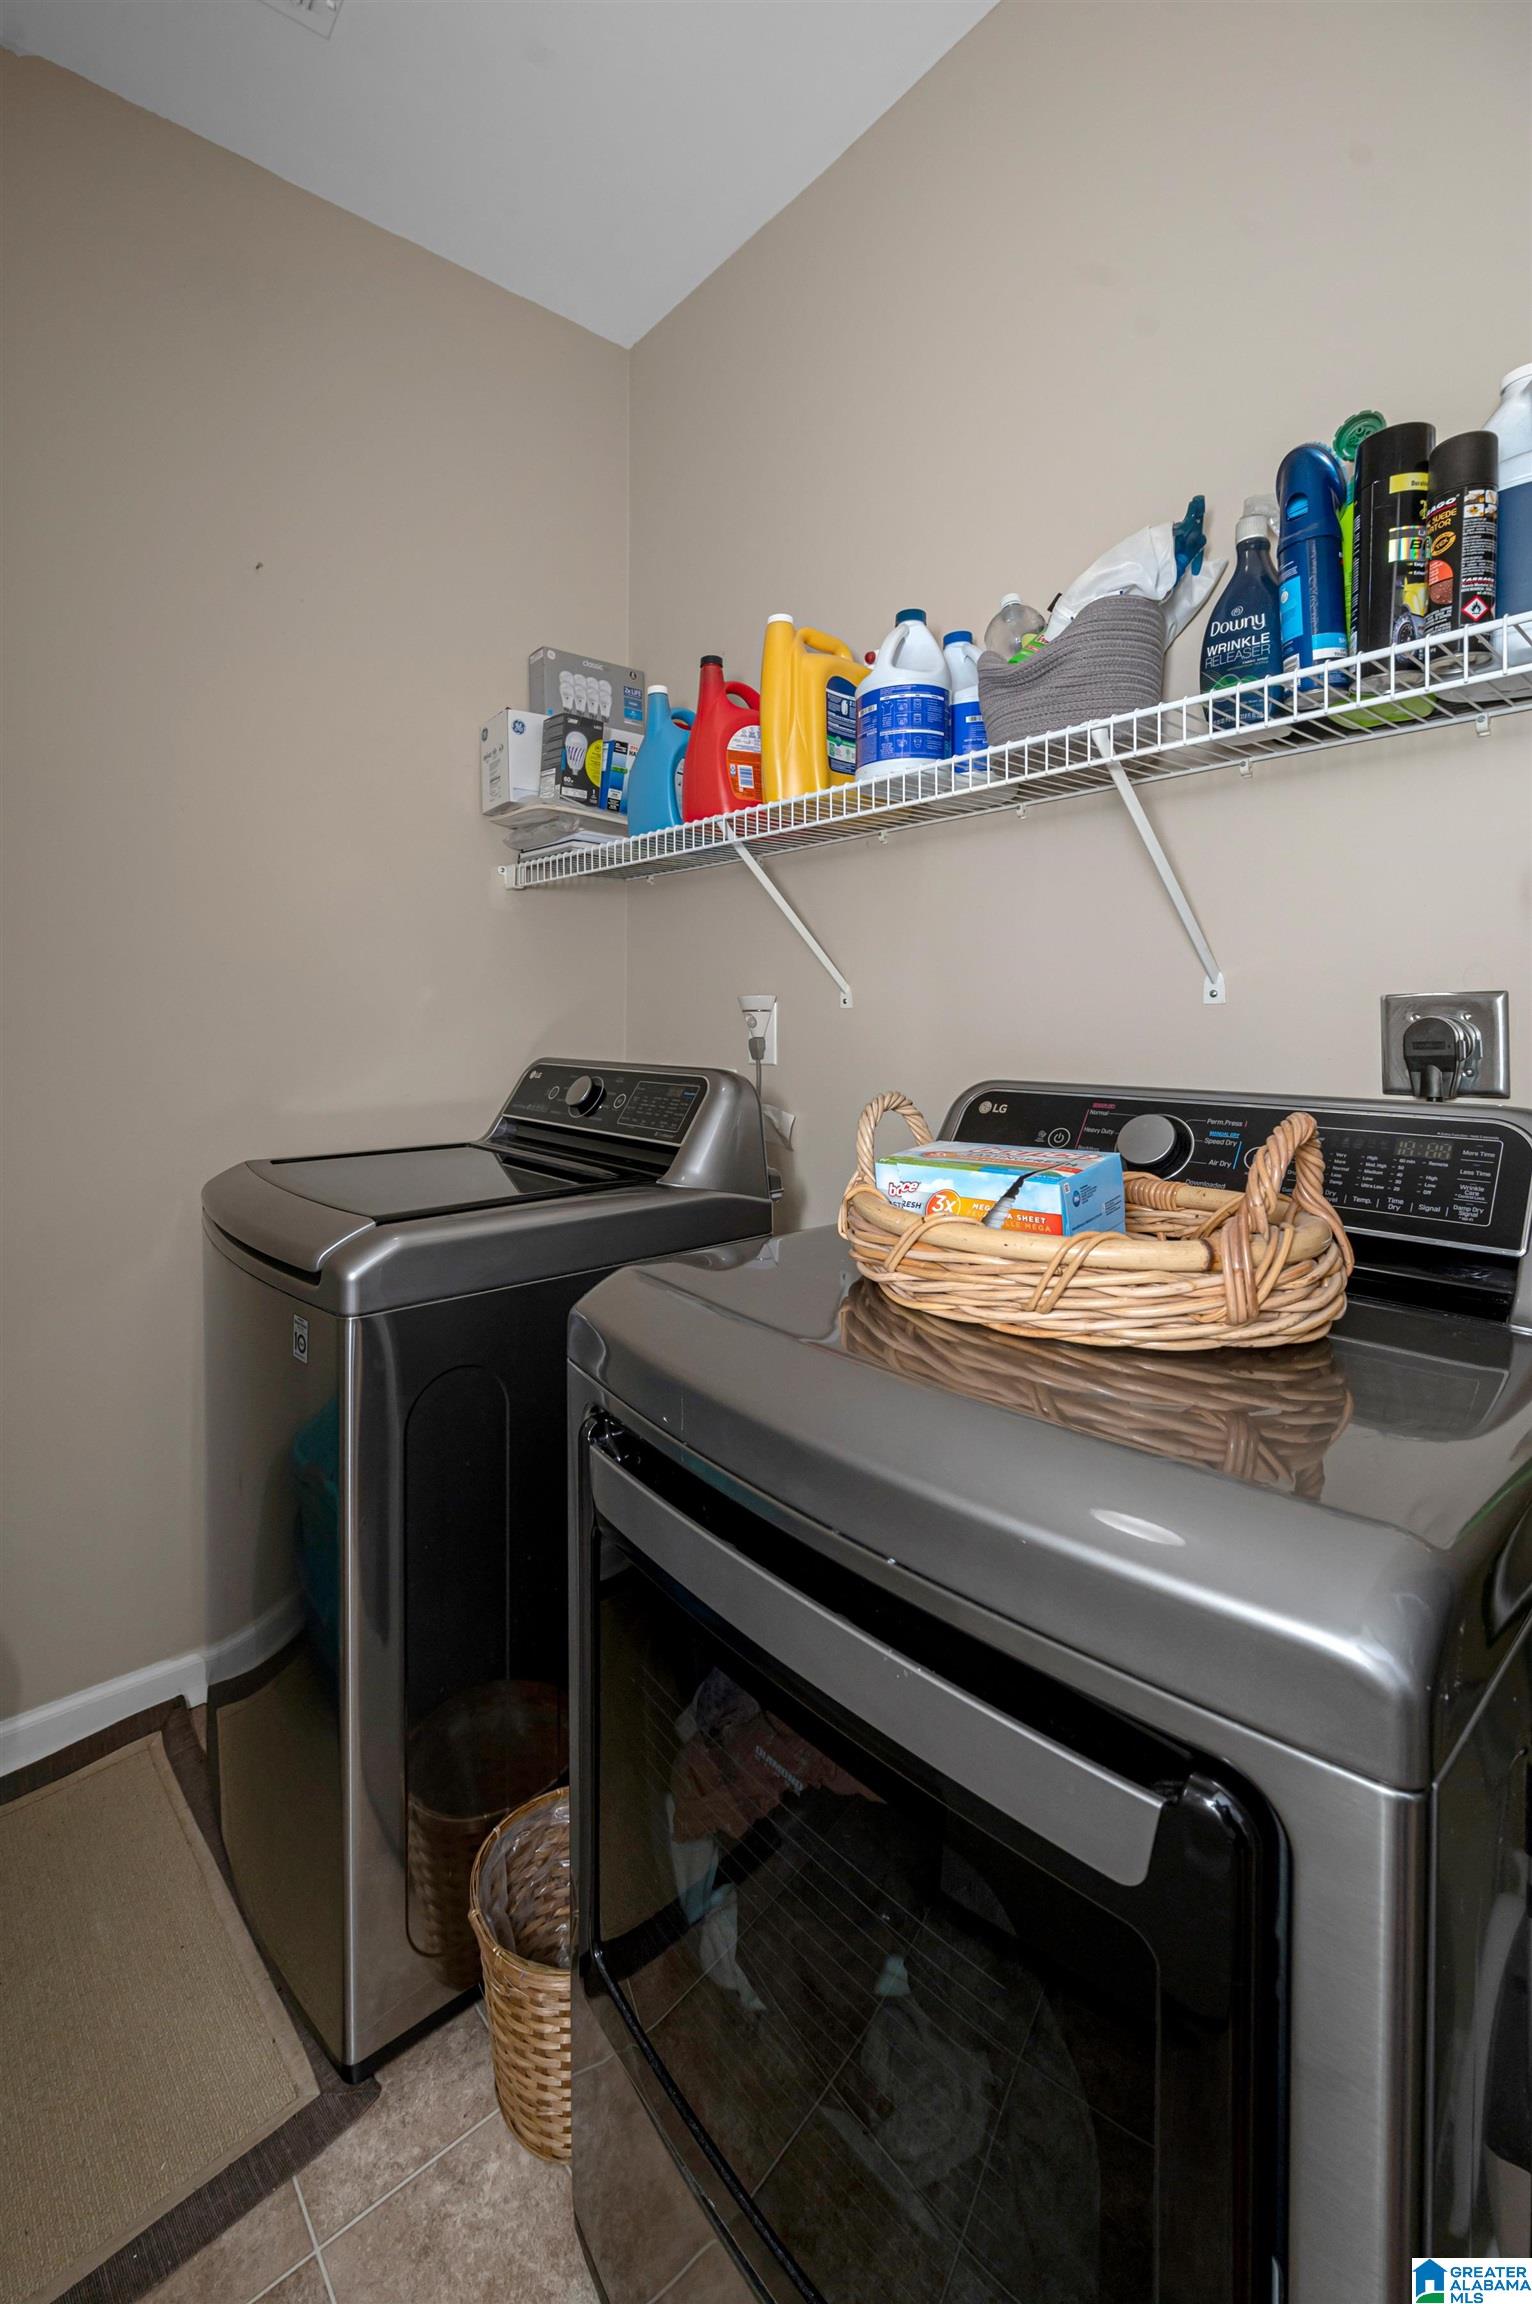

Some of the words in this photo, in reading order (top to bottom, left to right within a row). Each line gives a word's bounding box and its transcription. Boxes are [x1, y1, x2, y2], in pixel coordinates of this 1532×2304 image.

[1431, 508, 1457, 525] SUEDE
[1210, 612, 1266, 638] Downy
[1206, 632, 1271, 657] WRINKLE
[1204, 643, 1271, 670] RELEASER
[992, 1104, 1009, 1113] LG
[1084, 1126, 1101, 1134] Heavy
[1101, 1127, 1115, 1136] Duty
[1204, 1137, 1225, 1146] Speed
[1225, 1139, 1237, 1147] Dry
[1219, 1160, 1231, 1168] Dry
[1459, 1168, 1475, 1176] Less
[1476, 1170, 1492, 1178] Time
[1325, 1189, 1337, 1197] Dry
[1459, 1184, 1485, 1192] Wrinkle
[1464, 1189, 1480, 1197] Care
[931, 1193, 957, 1213] 3x
[1353, 1195, 1372, 1204] Temp.
[1388, 1197, 1405, 1205] Time
[1388, 1203, 1401, 1212] Dry
[1418, 1203, 1441, 1213] Signal
[1472, 1206, 1485, 1215] Dry
[1016, 1214, 1047, 1224] SHEET
[1024, 1222, 1052, 1233] MEGA
